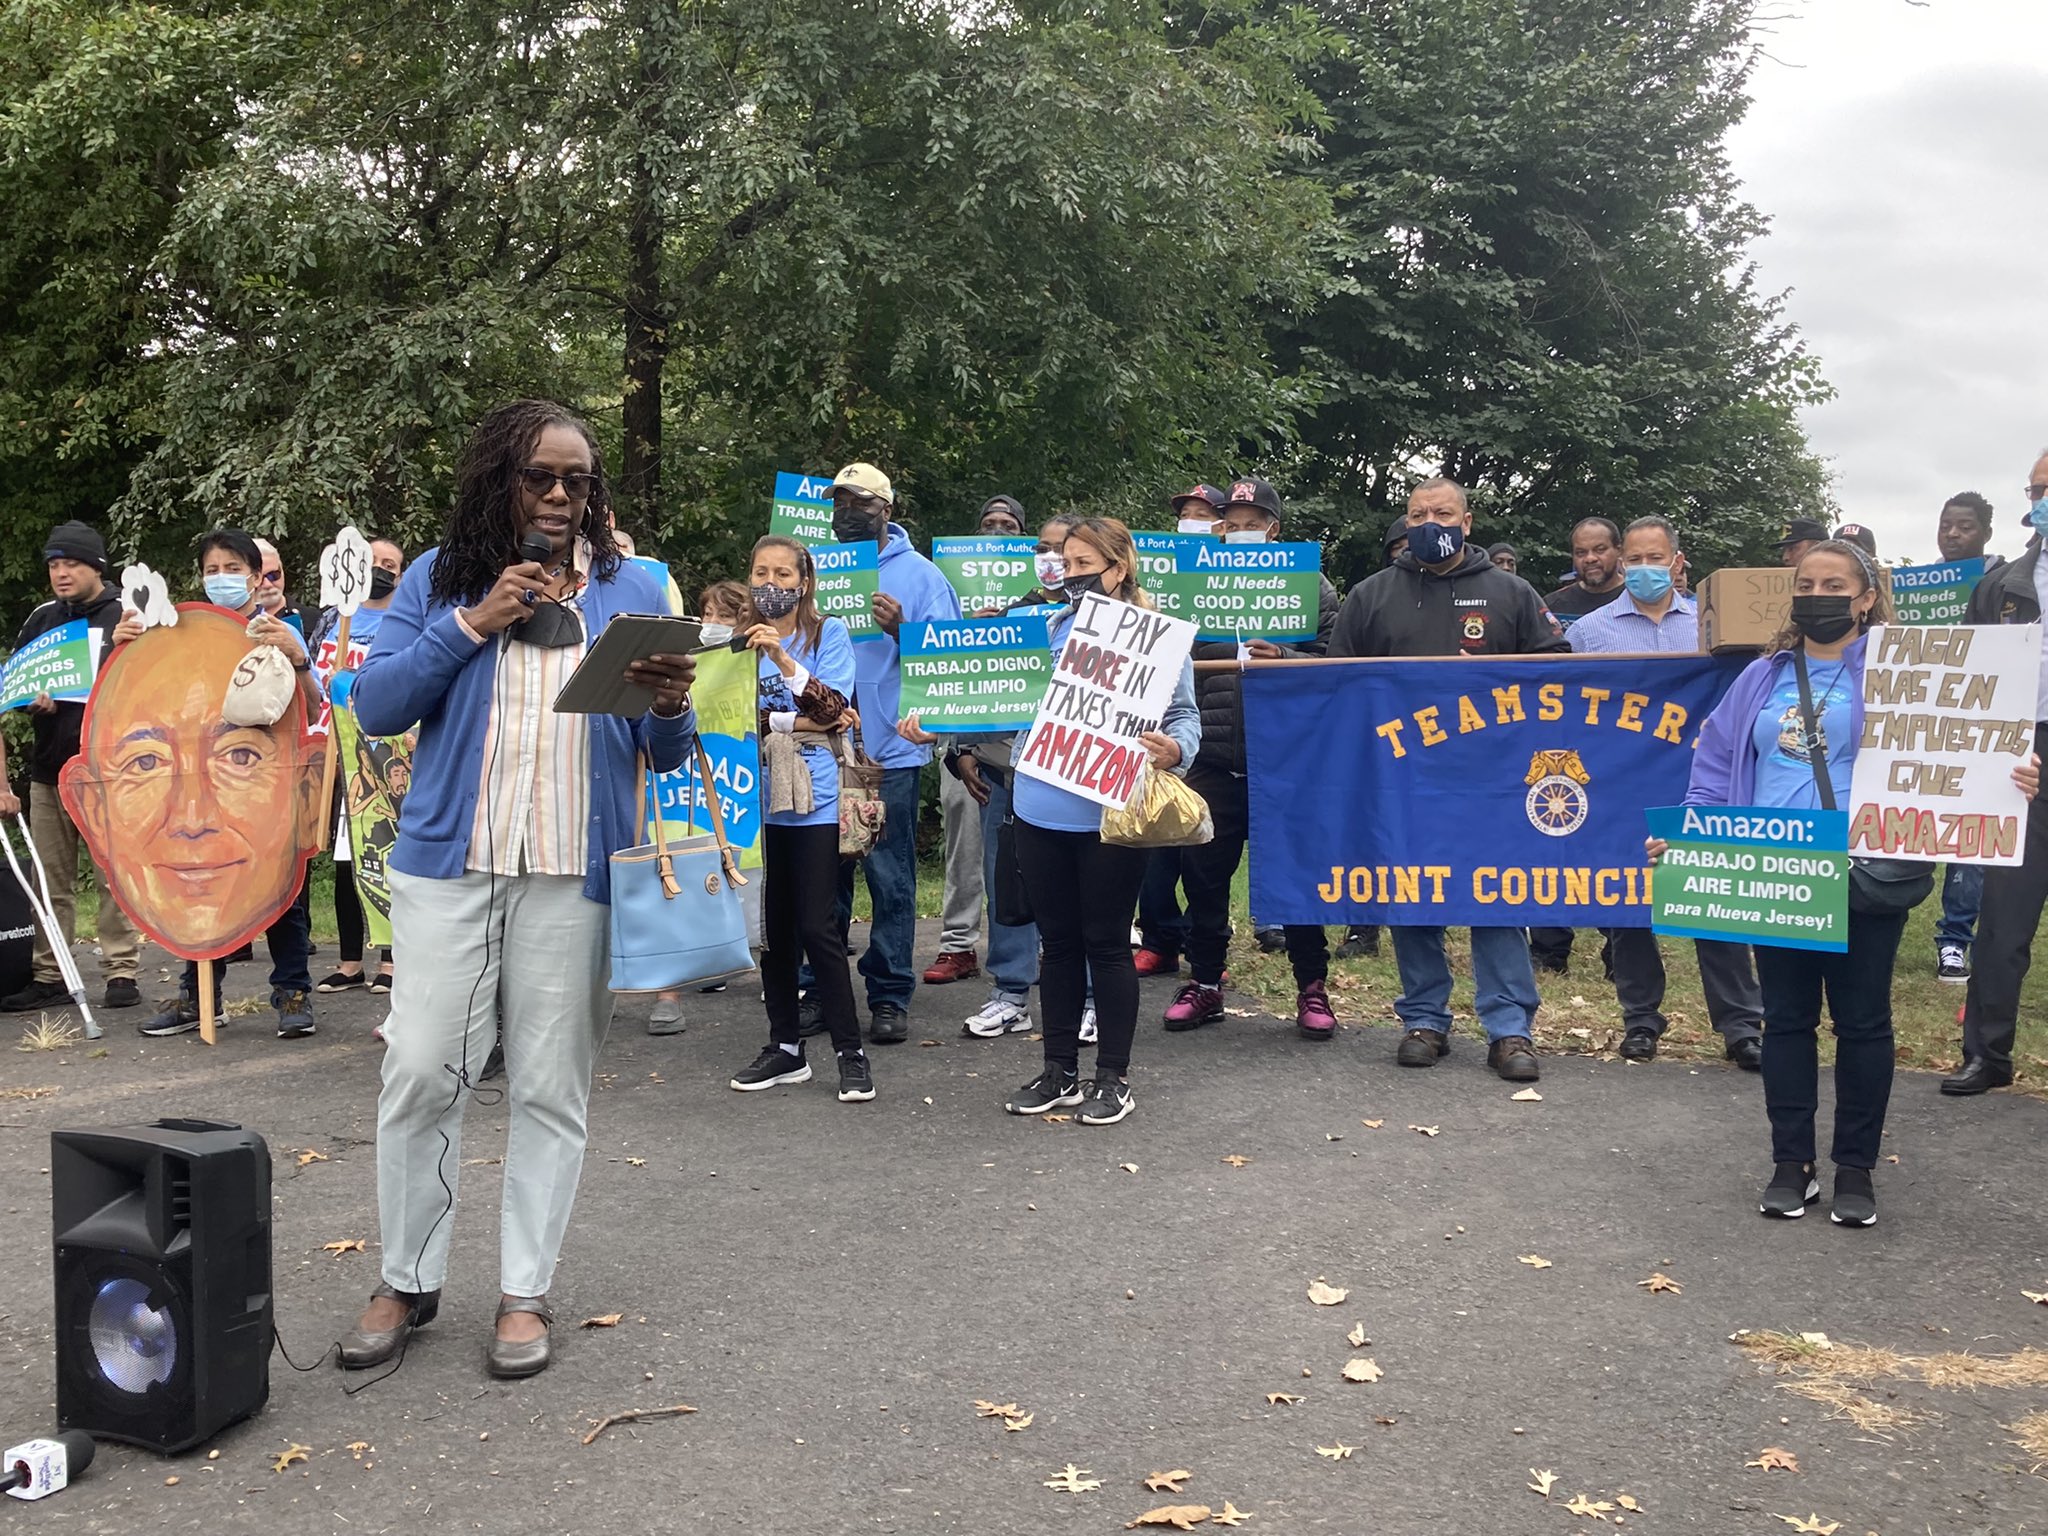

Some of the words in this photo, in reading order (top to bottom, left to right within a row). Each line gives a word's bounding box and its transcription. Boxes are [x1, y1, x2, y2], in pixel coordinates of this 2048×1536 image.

[777, 504, 834, 523] TRABAJ
[792, 524, 827, 539] AIRE
[935, 543, 974, 554] Amazon
[976, 543, 984, 553] &
[985, 543, 1005, 554] Port
[1138, 537, 1146, 548] &
[1147, 538, 1166, 549] Port
[811, 550, 858, 568] azon:
[1195, 545, 1295, 567] Amazon:
[961, 561, 1027, 578] STOP
[1891, 567, 1962, 587] mazon:
[815, 575, 852, 592] eeds
[985, 580, 1003, 592] the
[1146, 576, 1164, 589] the
[1206, 576, 1229, 589] NJ
[1232, 576, 1287, 589] Needs
[822, 593, 865, 611] JOBS
[1193, 594, 1245, 609] GOOD
[1250, 595, 1302, 610] JOBS
[1908, 590, 1957, 605] Needs
[1073, 595, 1110, 637] I
[1111, 606, 1171, 655] PAY
[1204, 615, 1263, 630] CLEAN
[1266, 614, 1307, 630] AIR!
[1897, 609, 1921, 621] OD
[921, 623, 1023, 649] Amazon:
[1877, 628, 1975, 667] PAGO
[19, 649, 60, 672] Needs
[30, 658, 75, 678] JOBS
[904, 659, 982, 677] TRABAJO
[986, 655, 1046, 672] DIGNO,
[1060, 638, 1129, 691] MORE
[1123, 661, 1156, 699] IN
[1, 680, 41, 704] LEAN
[44, 673, 81, 690] AIR!
[925, 681, 964, 697] AIRE
[968, 678, 1027, 695] LIMPIO
[1864, 668, 1931, 704] MAS
[1936, 673, 1998, 711] EN
[908, 705, 940, 717] para
[943, 703, 988, 716] Nueva
[1045, 679, 1112, 730] TAXES
[1113, 710, 1158, 738] THAN
[1376, 684, 1706, 758] TEAMSTER
[1860, 711, 2033, 757] IMPUESTOS
[1023, 721, 1145, 803] AMAZON
[1887, 760, 1966, 796] QUE
[662, 786, 748, 825] JEREY
[1681, 807, 1814, 843] Amazon:
[1849, 803, 2018, 858] AMAZON
[1663, 849, 1756, 871] TRABAJO
[1762, 856, 1841, 880] DIGNO,
[1318, 866, 1451, 904] JOINT
[1683, 876, 1732, 895] AIRE
[1737, 880, 1812, 902] LIMPIO
[1663, 902, 1702, 916] para
[1706, 903, 1761, 922] Nueva
[1765, 909, 1833, 931] Jersey!
